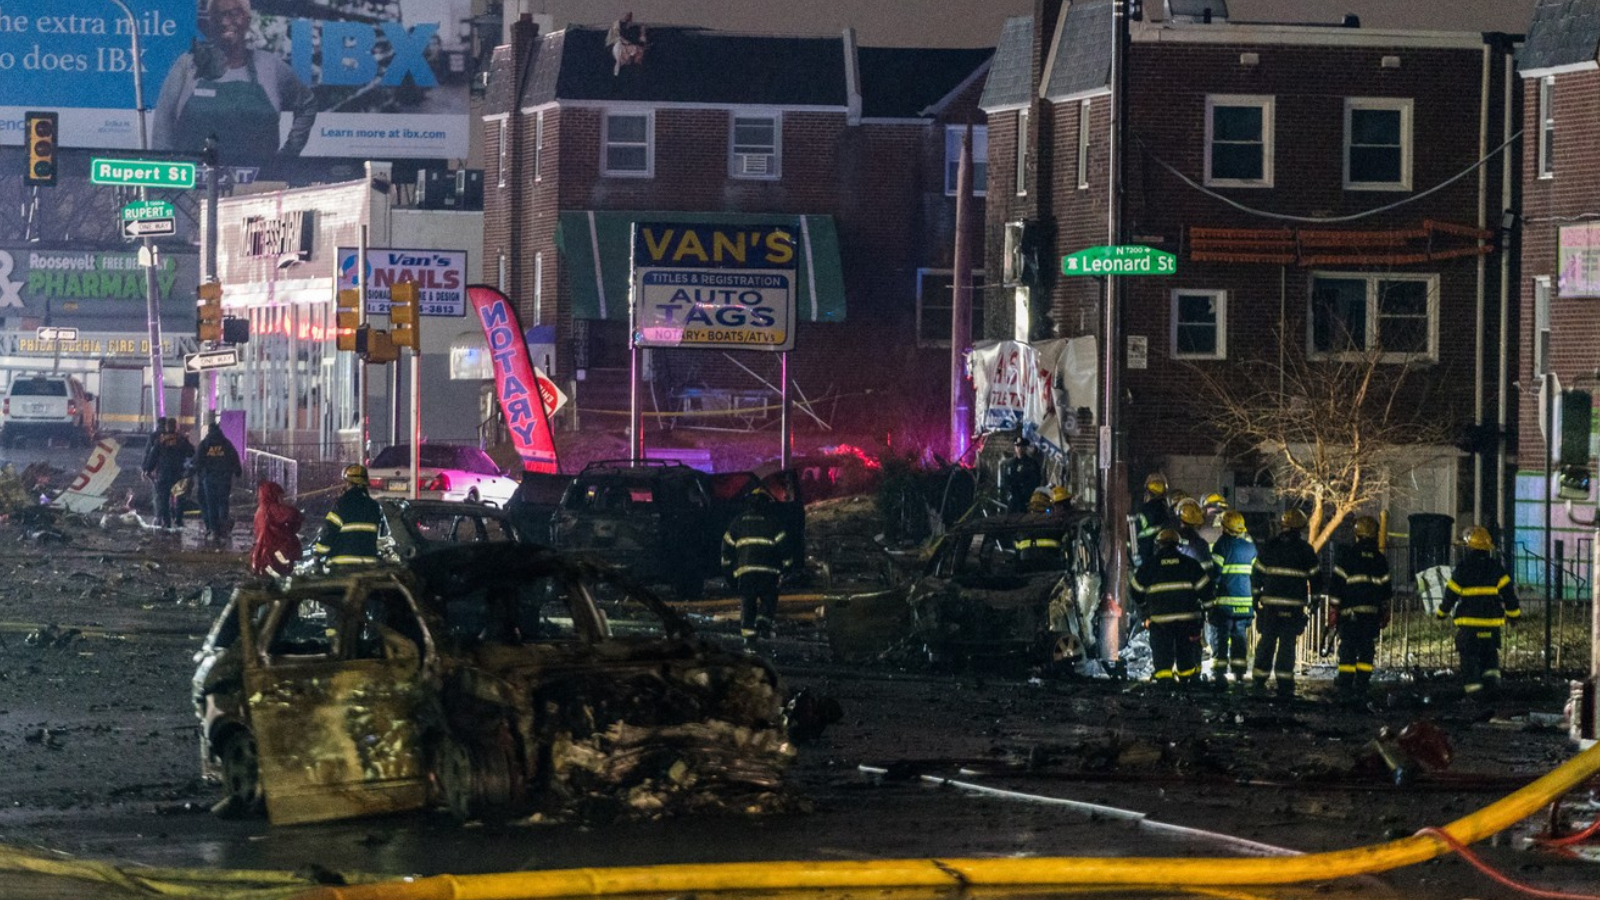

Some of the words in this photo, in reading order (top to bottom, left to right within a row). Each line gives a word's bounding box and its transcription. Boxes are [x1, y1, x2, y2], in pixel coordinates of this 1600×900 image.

[36, 15, 107, 34] extra
[115, 10, 177, 36] mile
[23, 44, 87, 71] does
[97, 48, 148, 72] IBX
[290, 18, 440, 87] IBX
[320, 128, 353, 138] Learn
[356, 129, 386, 138] more
[388, 129, 400, 138] at
[403, 129, 446, 139] ibx.com
[100, 164, 160, 181] Rupert
[168, 167, 187, 181] St
[125, 206, 164, 218] RUPERT
[642, 228, 794, 264] VAN'S
[1116, 246, 1124, 255] N
[29, 252, 96, 270] Roosevelt
[102, 256, 124, 270] FREE
[388, 253, 451, 266] Van's
[1082, 255, 1151, 272] Leonard
[1157, 256, 1174, 271] St
[374, 267, 460, 290] NAILS
[652, 273, 688, 283] TITLES
[691, 273, 698, 284] &
[701, 274, 781, 287] REGISTRATION
[436, 291, 460, 301] DESIGN
[669, 288, 763, 306] AUTO
[656, 304, 775, 327] TAGS
[655, 329, 700, 341] NOTARY
[20, 339, 100, 352] PHILAELPHIA
[108, 340, 135, 353] FIRE
